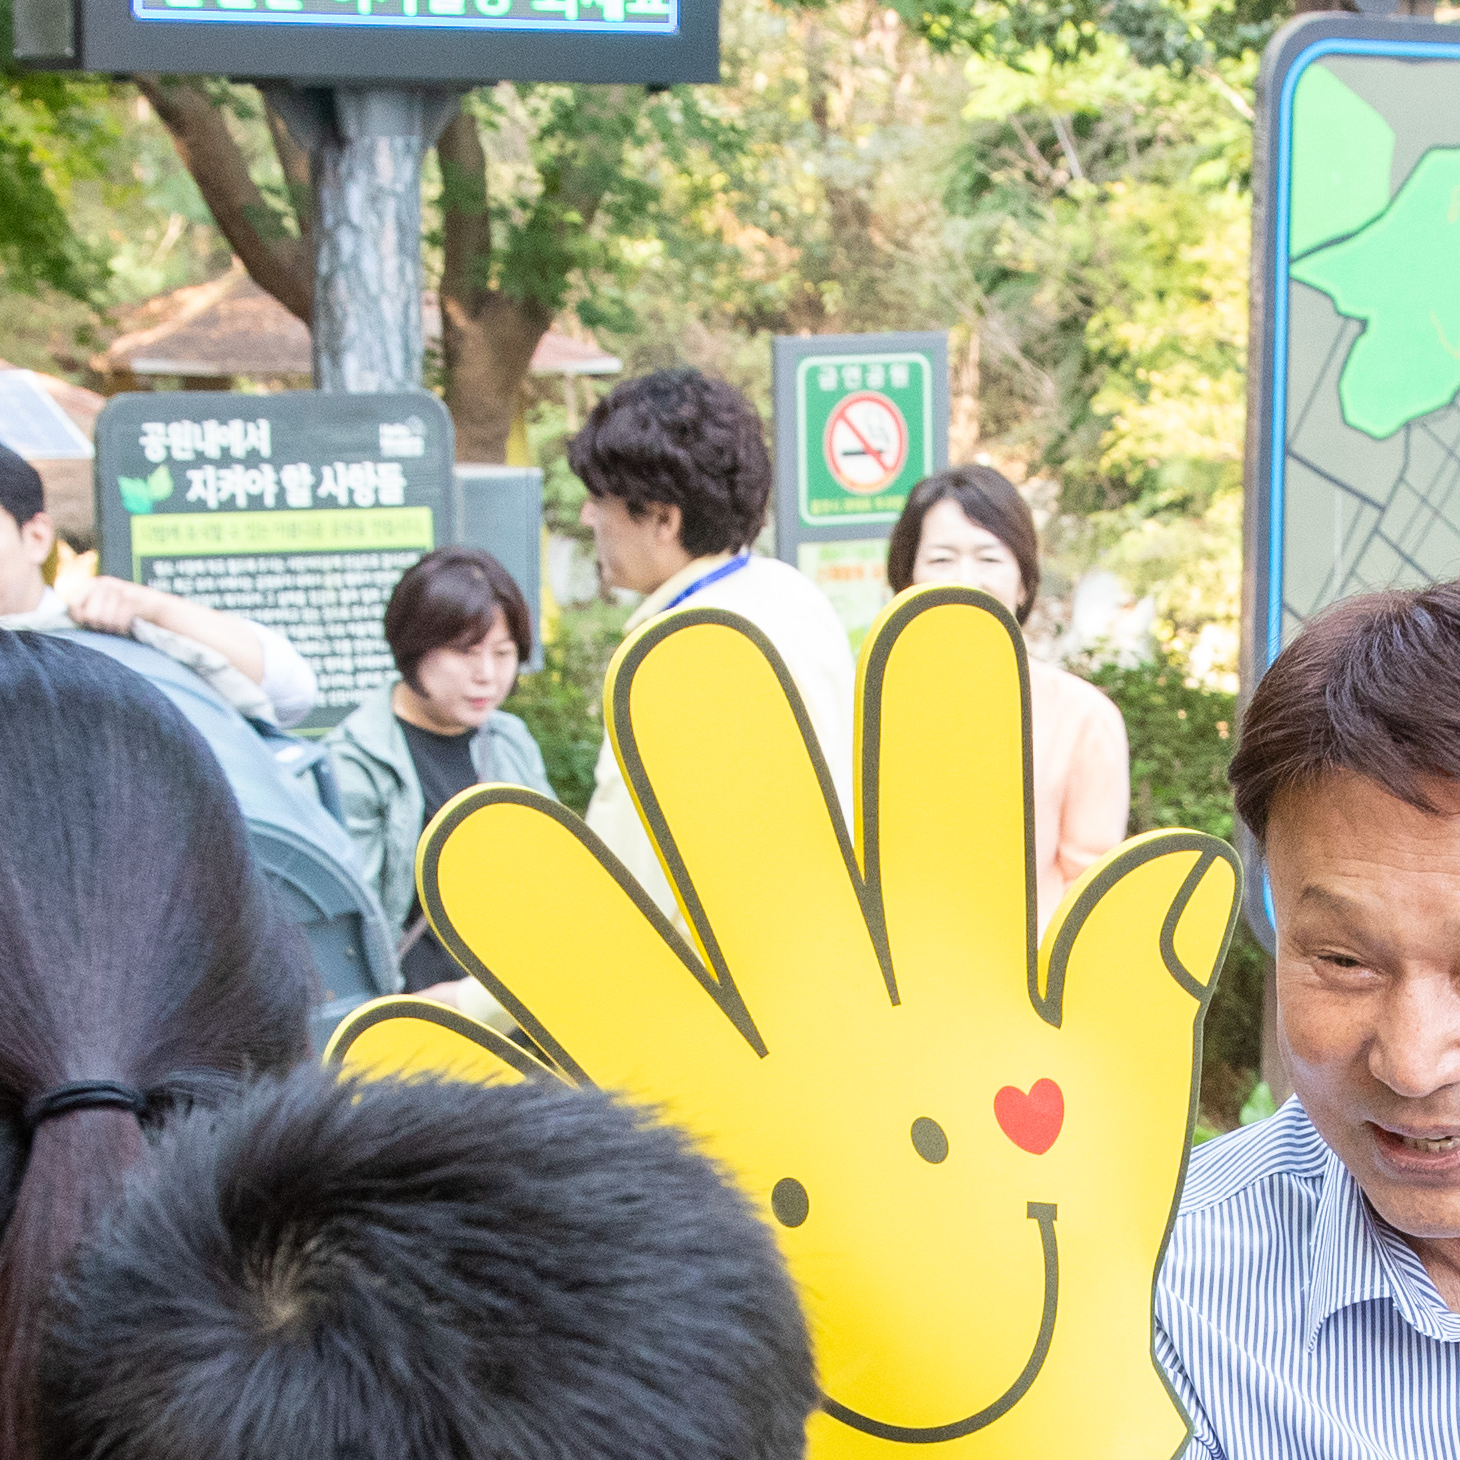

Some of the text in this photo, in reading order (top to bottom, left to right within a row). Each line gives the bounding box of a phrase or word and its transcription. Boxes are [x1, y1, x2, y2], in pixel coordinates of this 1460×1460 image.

[139, 418, 272, 463] 공원내에서
[186, 461, 407, 510] 지켜야 할 사항들
